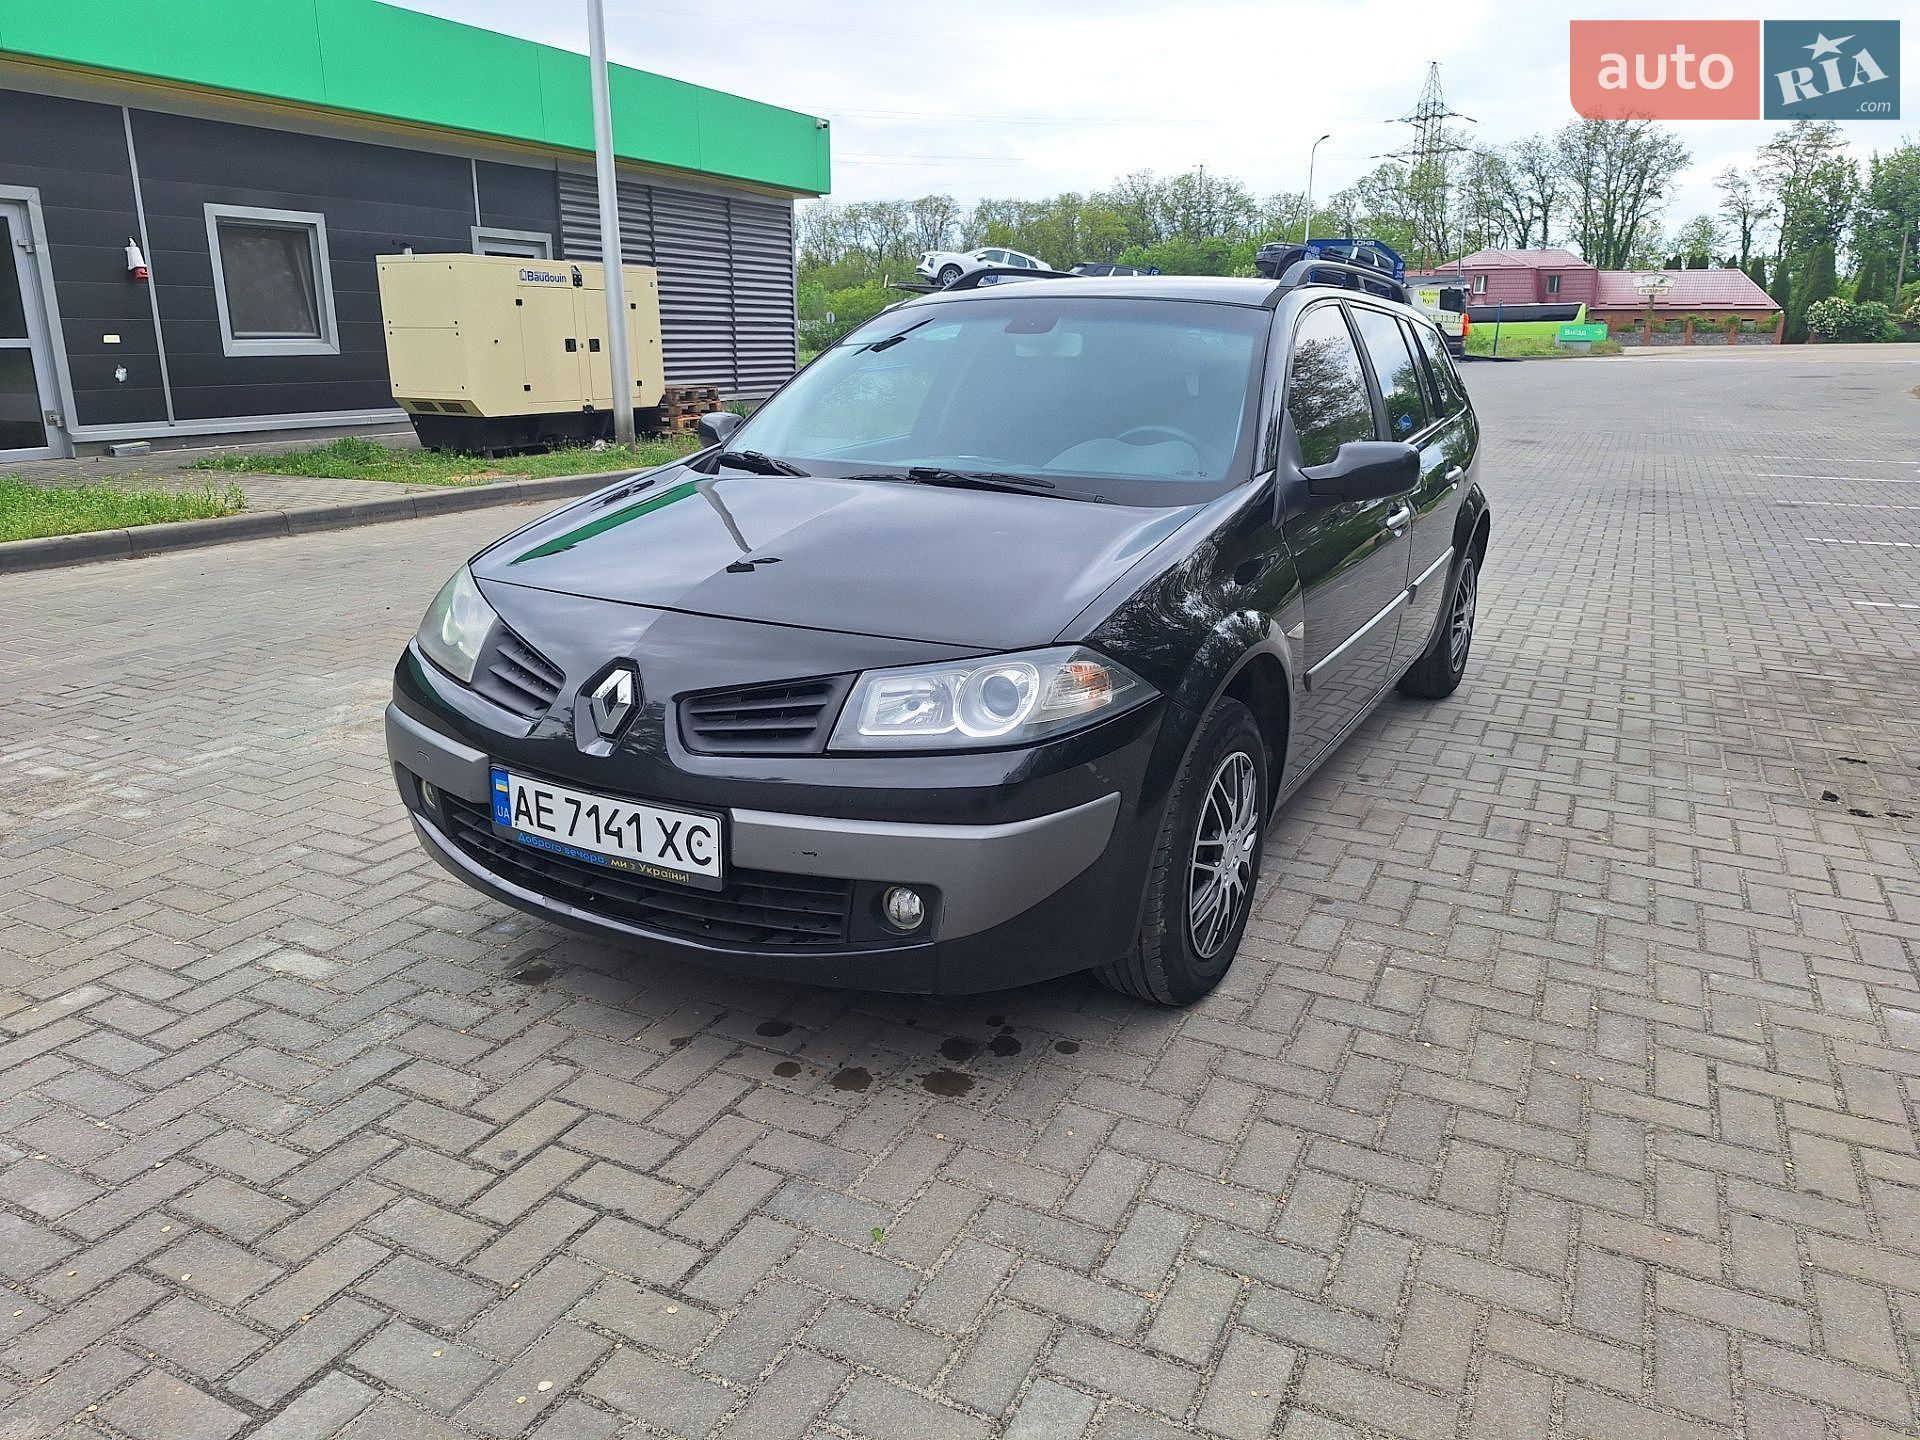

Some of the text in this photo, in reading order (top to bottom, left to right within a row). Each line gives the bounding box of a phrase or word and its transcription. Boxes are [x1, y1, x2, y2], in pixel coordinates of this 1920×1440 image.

[527, 270, 567, 283] Baudouin
[497, 806, 510, 819] UA
[514, 785, 712, 866] AE 7141 XC
[518, 832, 562, 853] Доброго
[610, 859, 628, 869] ми
[639, 863, 690, 883] України!
